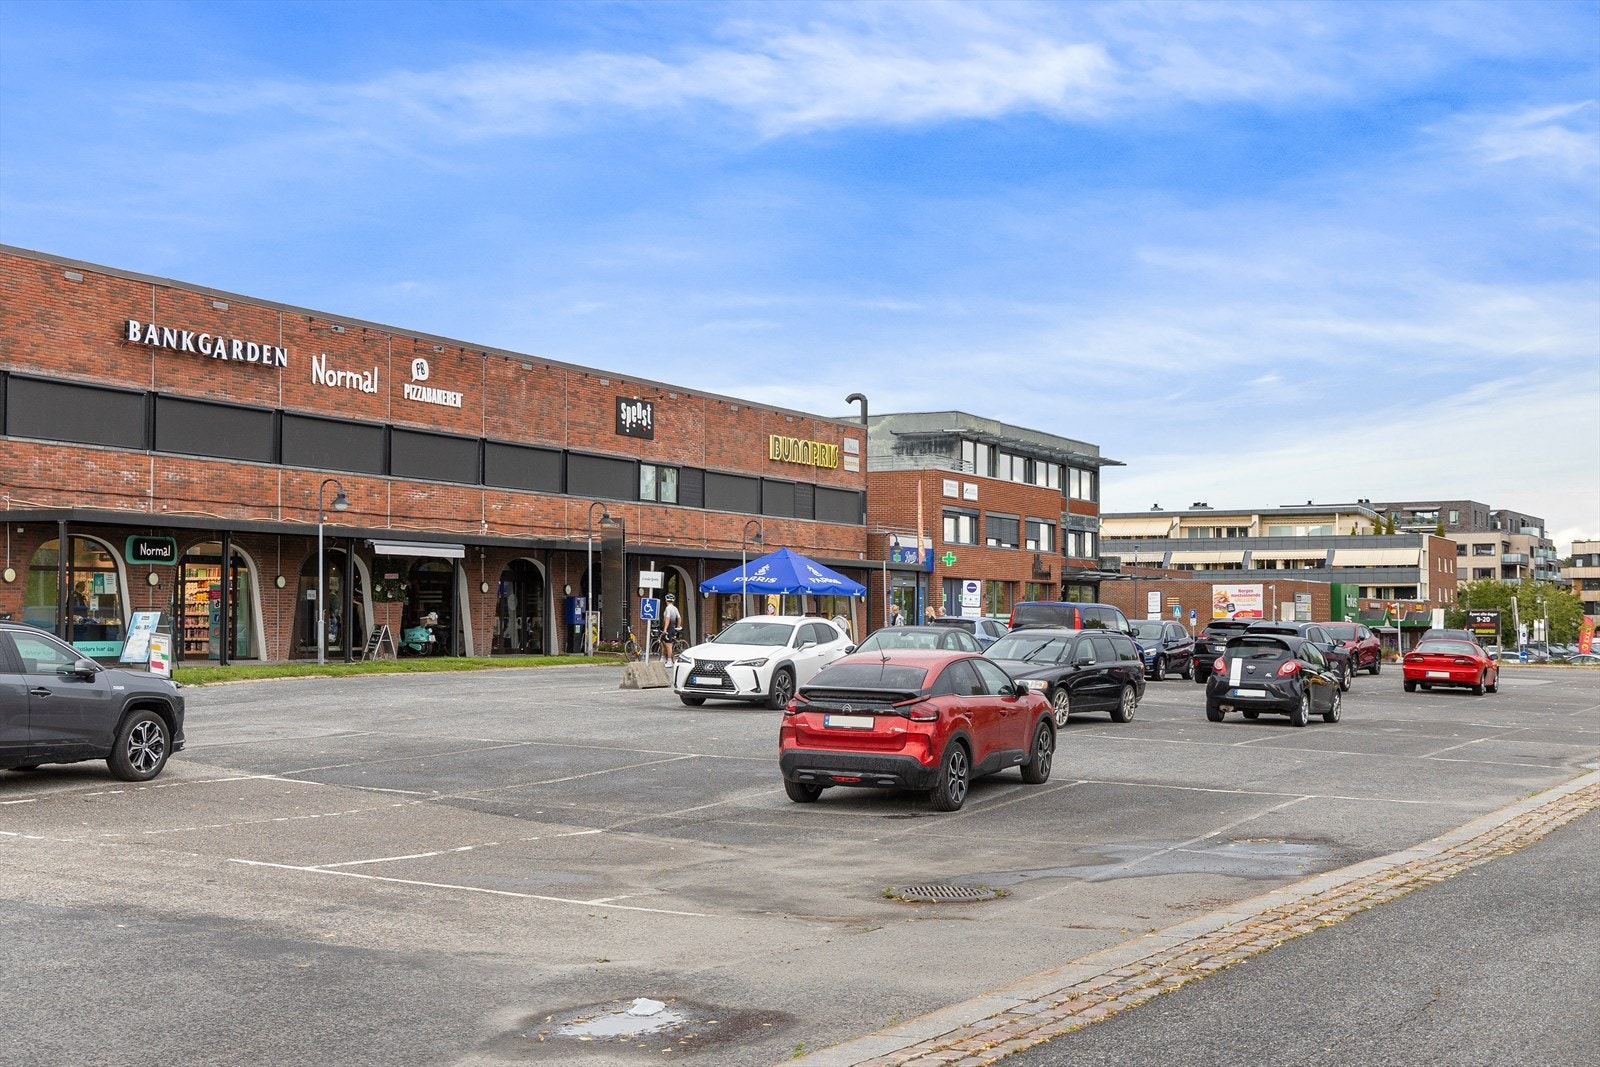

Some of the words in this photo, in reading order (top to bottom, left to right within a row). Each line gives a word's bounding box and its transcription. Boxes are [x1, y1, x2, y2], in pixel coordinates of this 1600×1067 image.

[312, 353, 378, 393] Normal
[769, 434, 839, 469] BUNNPRIS
[140, 542, 171, 557] Normal
